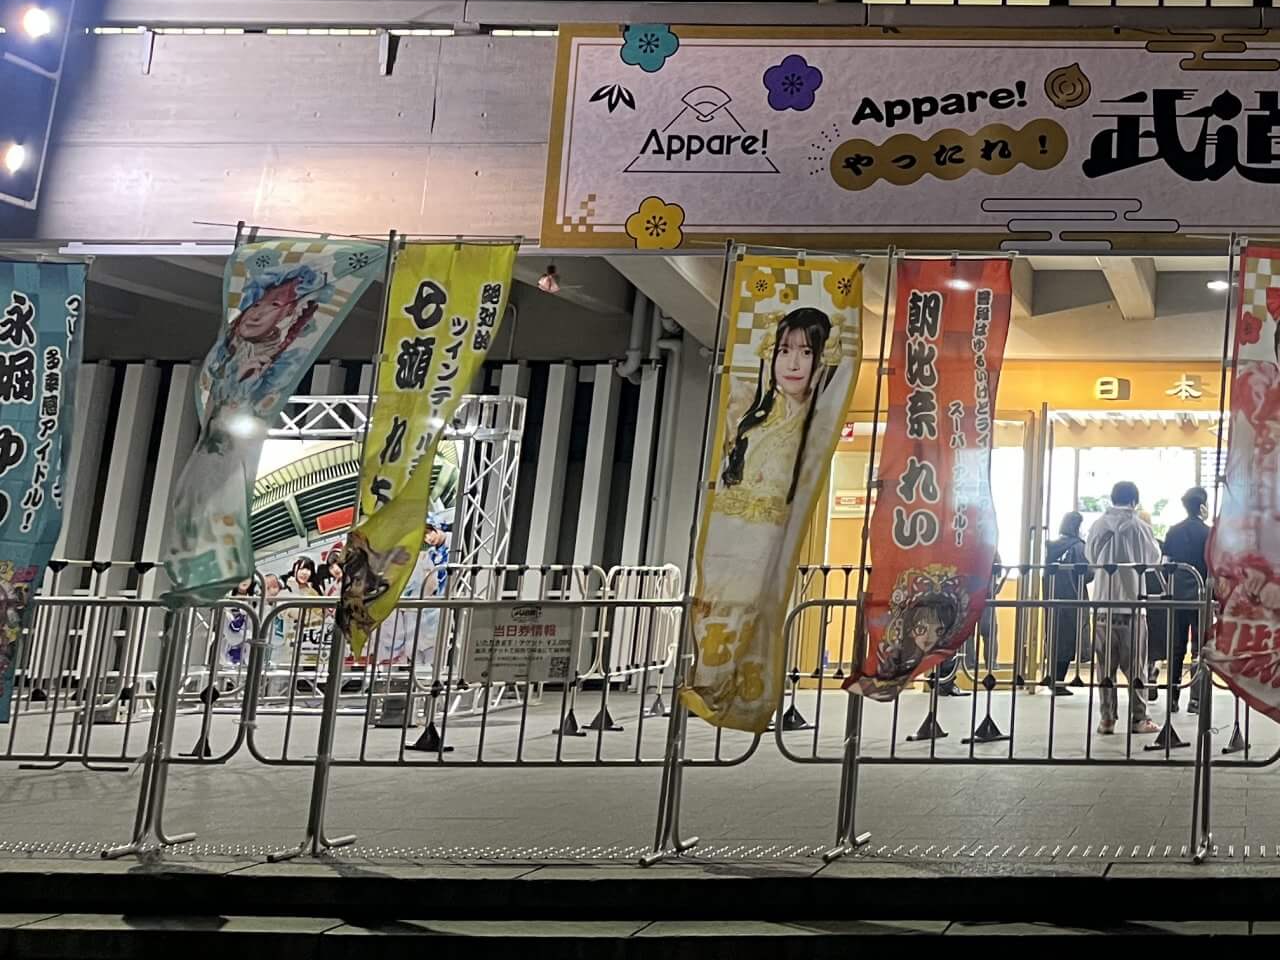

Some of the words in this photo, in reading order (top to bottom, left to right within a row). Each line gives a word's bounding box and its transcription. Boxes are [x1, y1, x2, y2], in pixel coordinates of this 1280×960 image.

[852, 81, 1027, 127] Appare!
[640, 129, 768, 160] Appare!
[842, 135, 1047, 176] やったれ！
[906, 291, 942, 440] 朝比奈
[894, 457, 940, 548] れい
